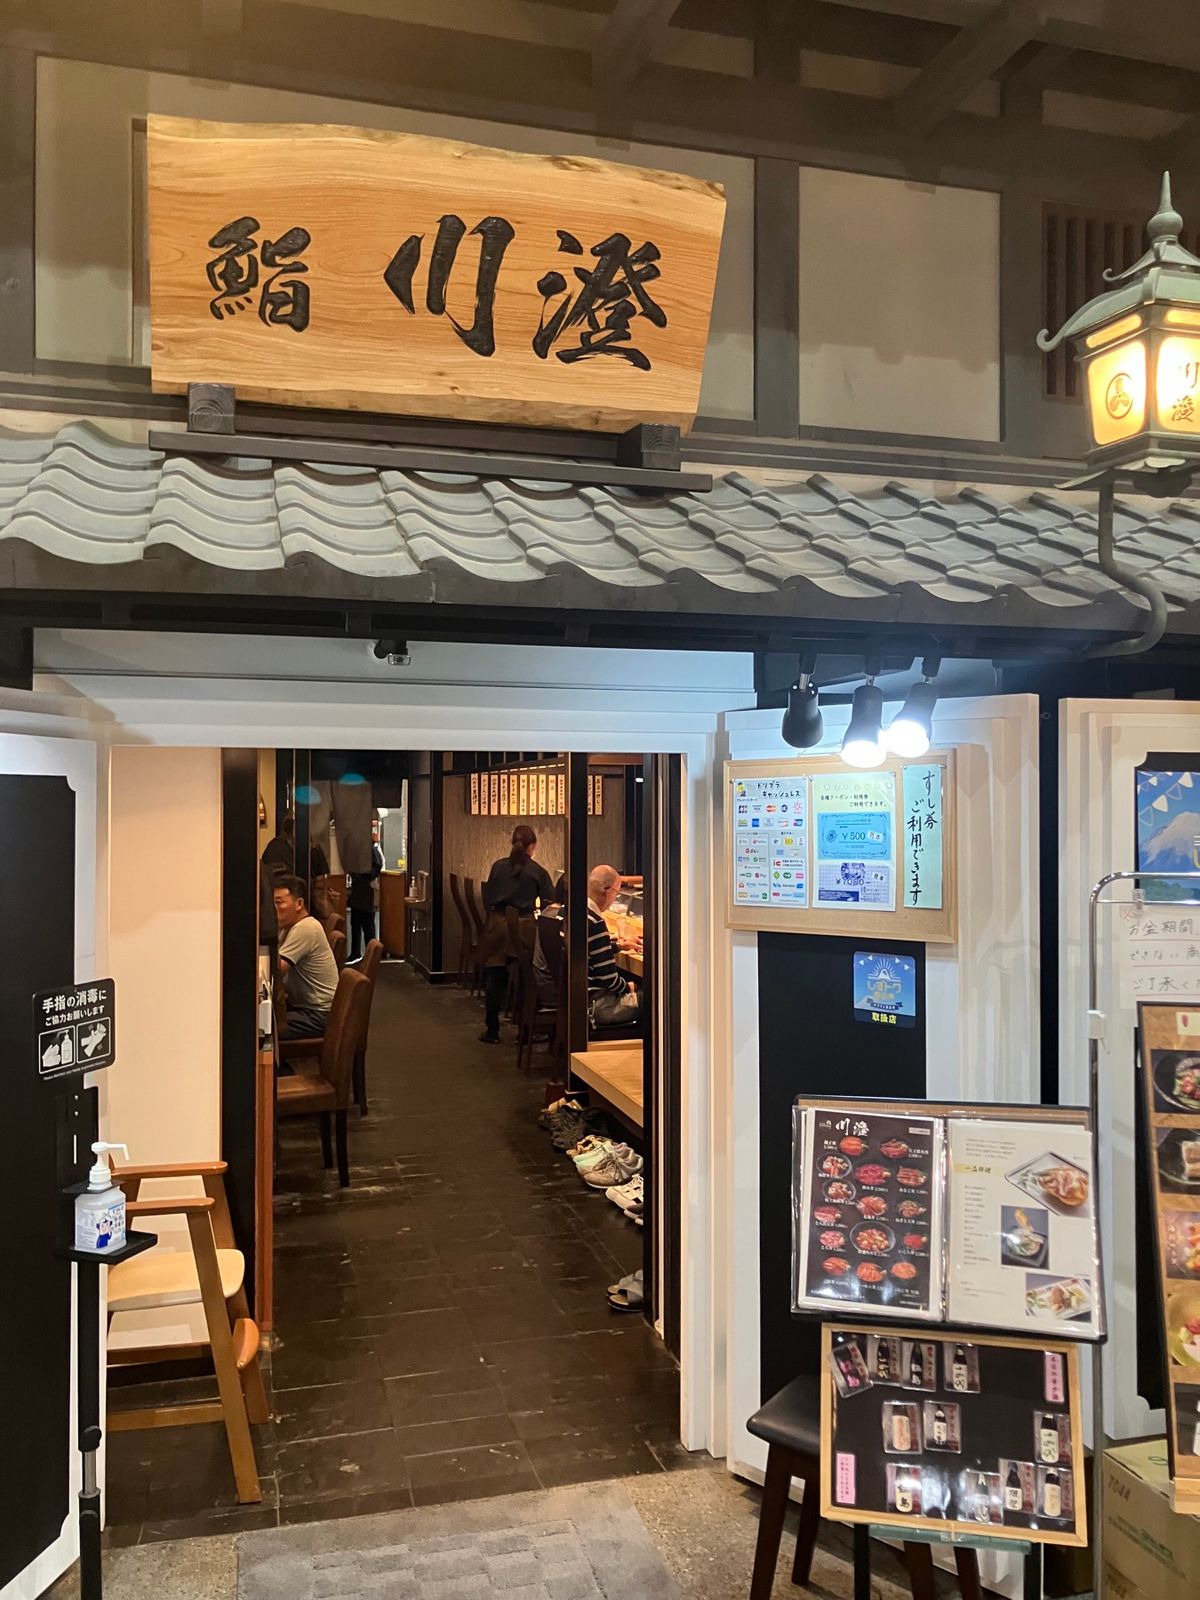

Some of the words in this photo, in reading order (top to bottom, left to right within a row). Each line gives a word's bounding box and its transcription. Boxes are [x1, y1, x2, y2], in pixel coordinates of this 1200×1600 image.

[206, 216, 312, 334] 鮨
[762, 790, 801, 798] キャッシュレス
[922, 770, 938, 830] すし券
[906, 798, 924, 906] ご利用できます
[42, 988, 108, 1014] 手指の消毒に
[45, 1005, 105, 1027] ご協力お願いします
